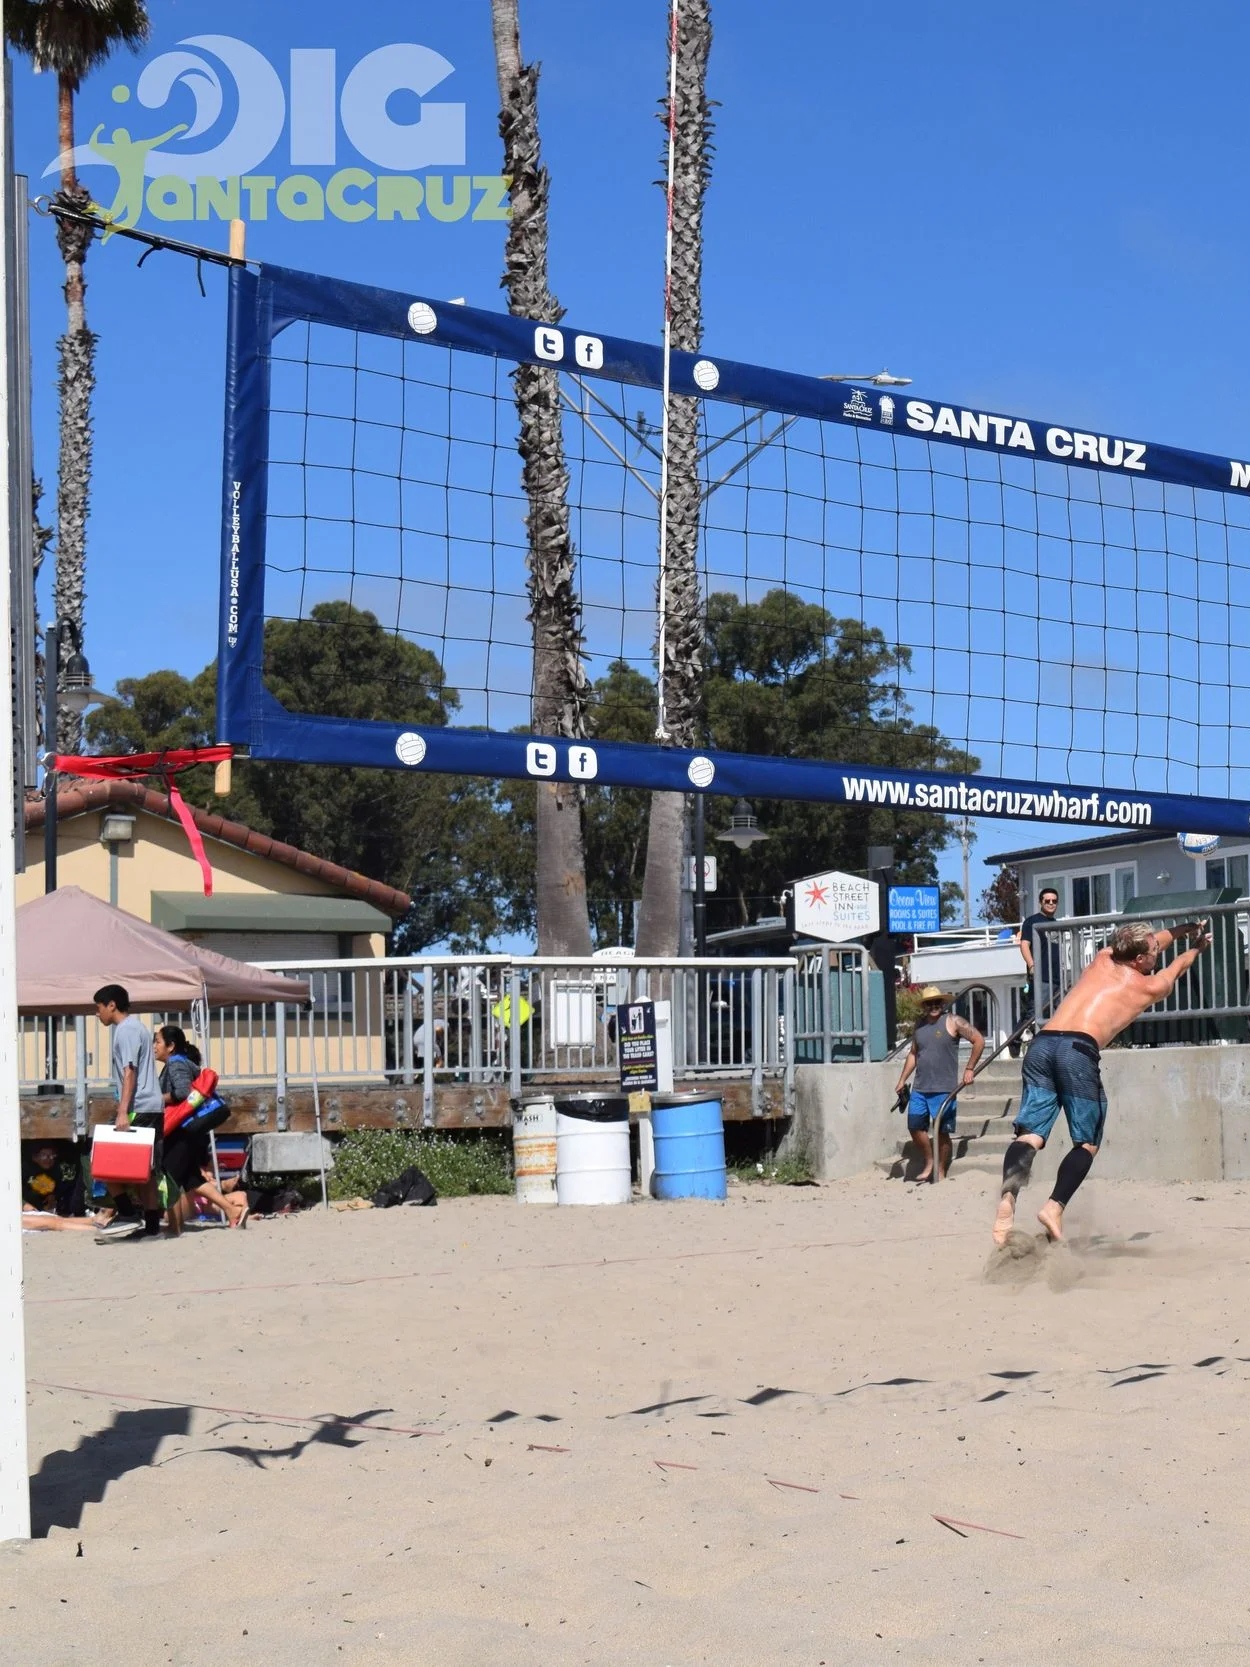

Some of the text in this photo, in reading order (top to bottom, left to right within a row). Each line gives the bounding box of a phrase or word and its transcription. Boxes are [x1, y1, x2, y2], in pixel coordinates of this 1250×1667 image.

[906, 400, 1146, 471] SANTA CRUZ
[842, 775, 1152, 826] www.santacruzwharf.com
[832, 882, 870, 891] BEACH
[833, 893, 869, 902] STREET
[833, 911, 870, 920] SUITES
[889, 909, 910, 919] ROOMS
[918, 909, 937, 919] SUITES
[891, 921, 906, 930] POOL
[914, 921, 926, 930] FIRE
[927, 921, 936, 930] PIT
